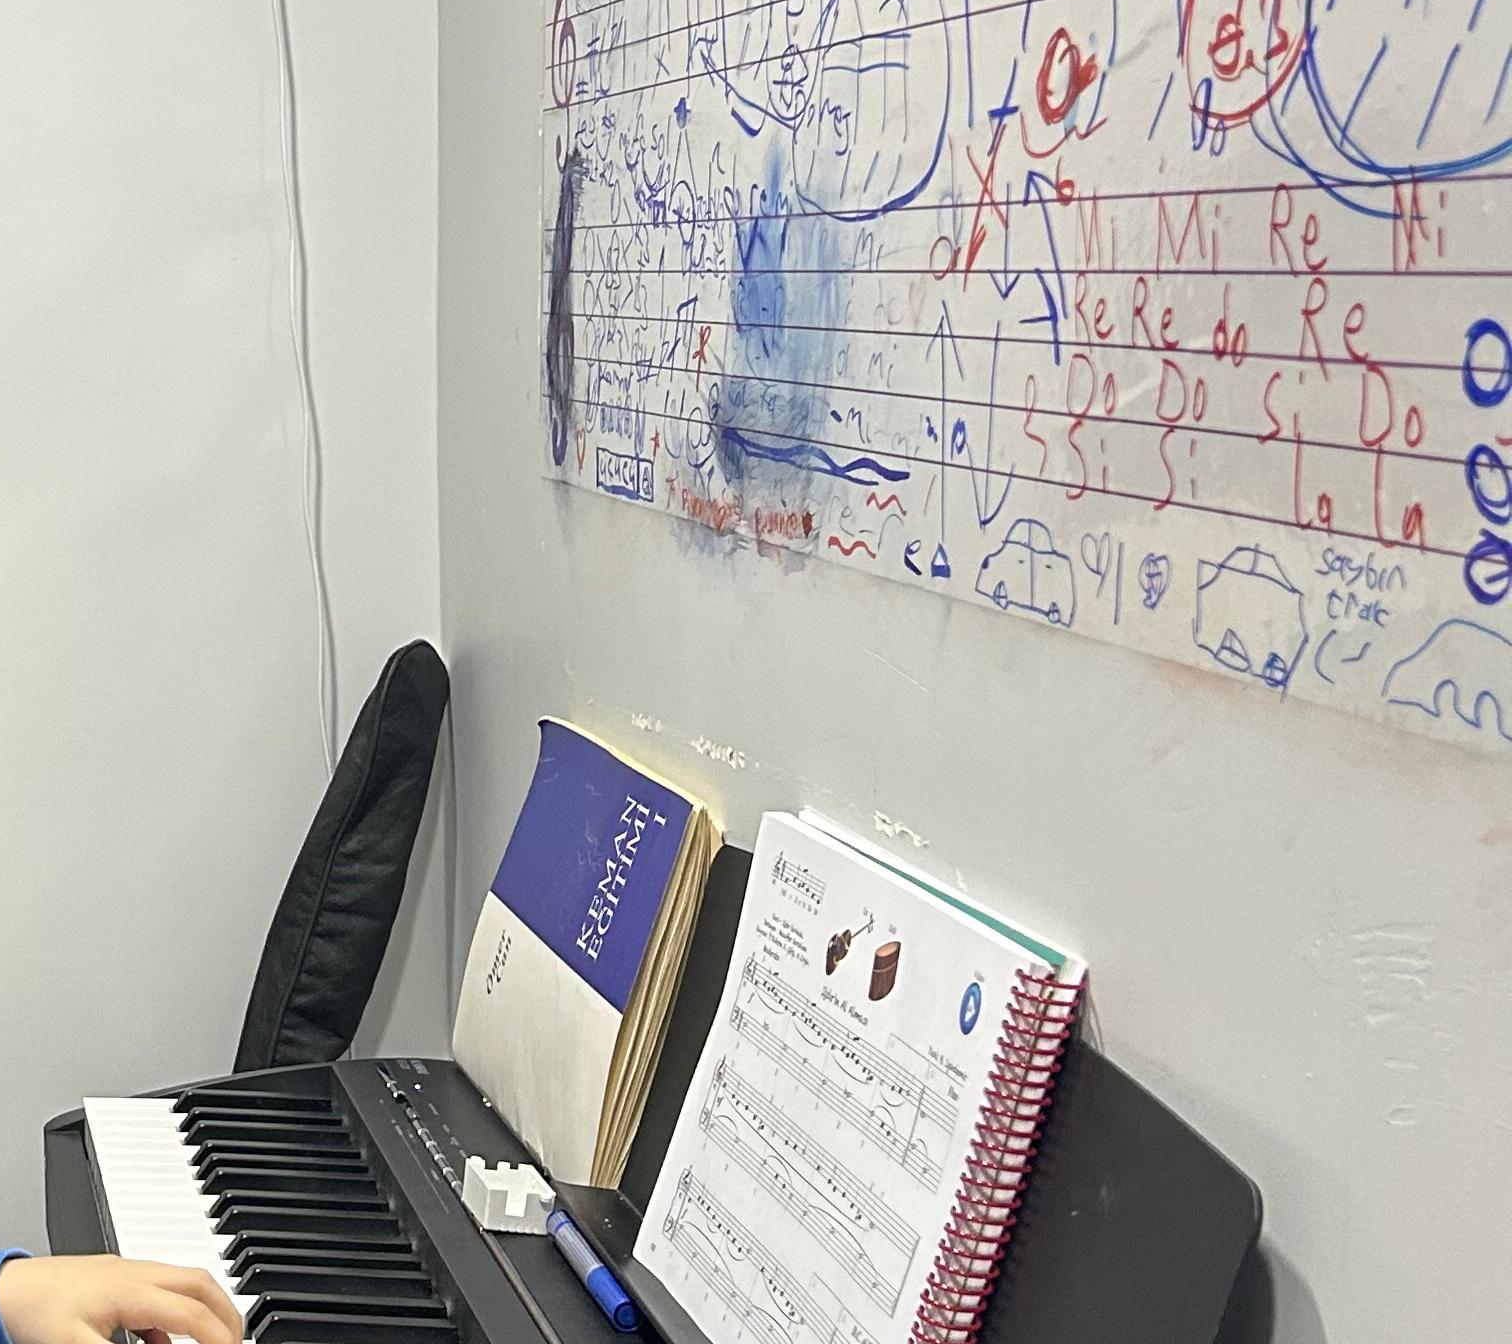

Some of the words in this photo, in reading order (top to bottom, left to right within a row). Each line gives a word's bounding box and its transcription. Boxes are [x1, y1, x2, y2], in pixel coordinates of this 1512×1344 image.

[1157, 193, 1221, 280] Mi
[1270, 183, 1328, 277] Re
[1075, 271, 1114, 351] Re
[1132, 276, 1180, 350] Re
[1300, 276, 1370, 380] Re
[1066, 353, 1118, 417] Do
[1156, 358, 1208, 423] Do
[1359, 364, 1424, 449] Do
[1066, 419, 1108, 500] Si
[1154, 424, 1198, 510] Si
[576, 794, 643, 953] KEMAN
